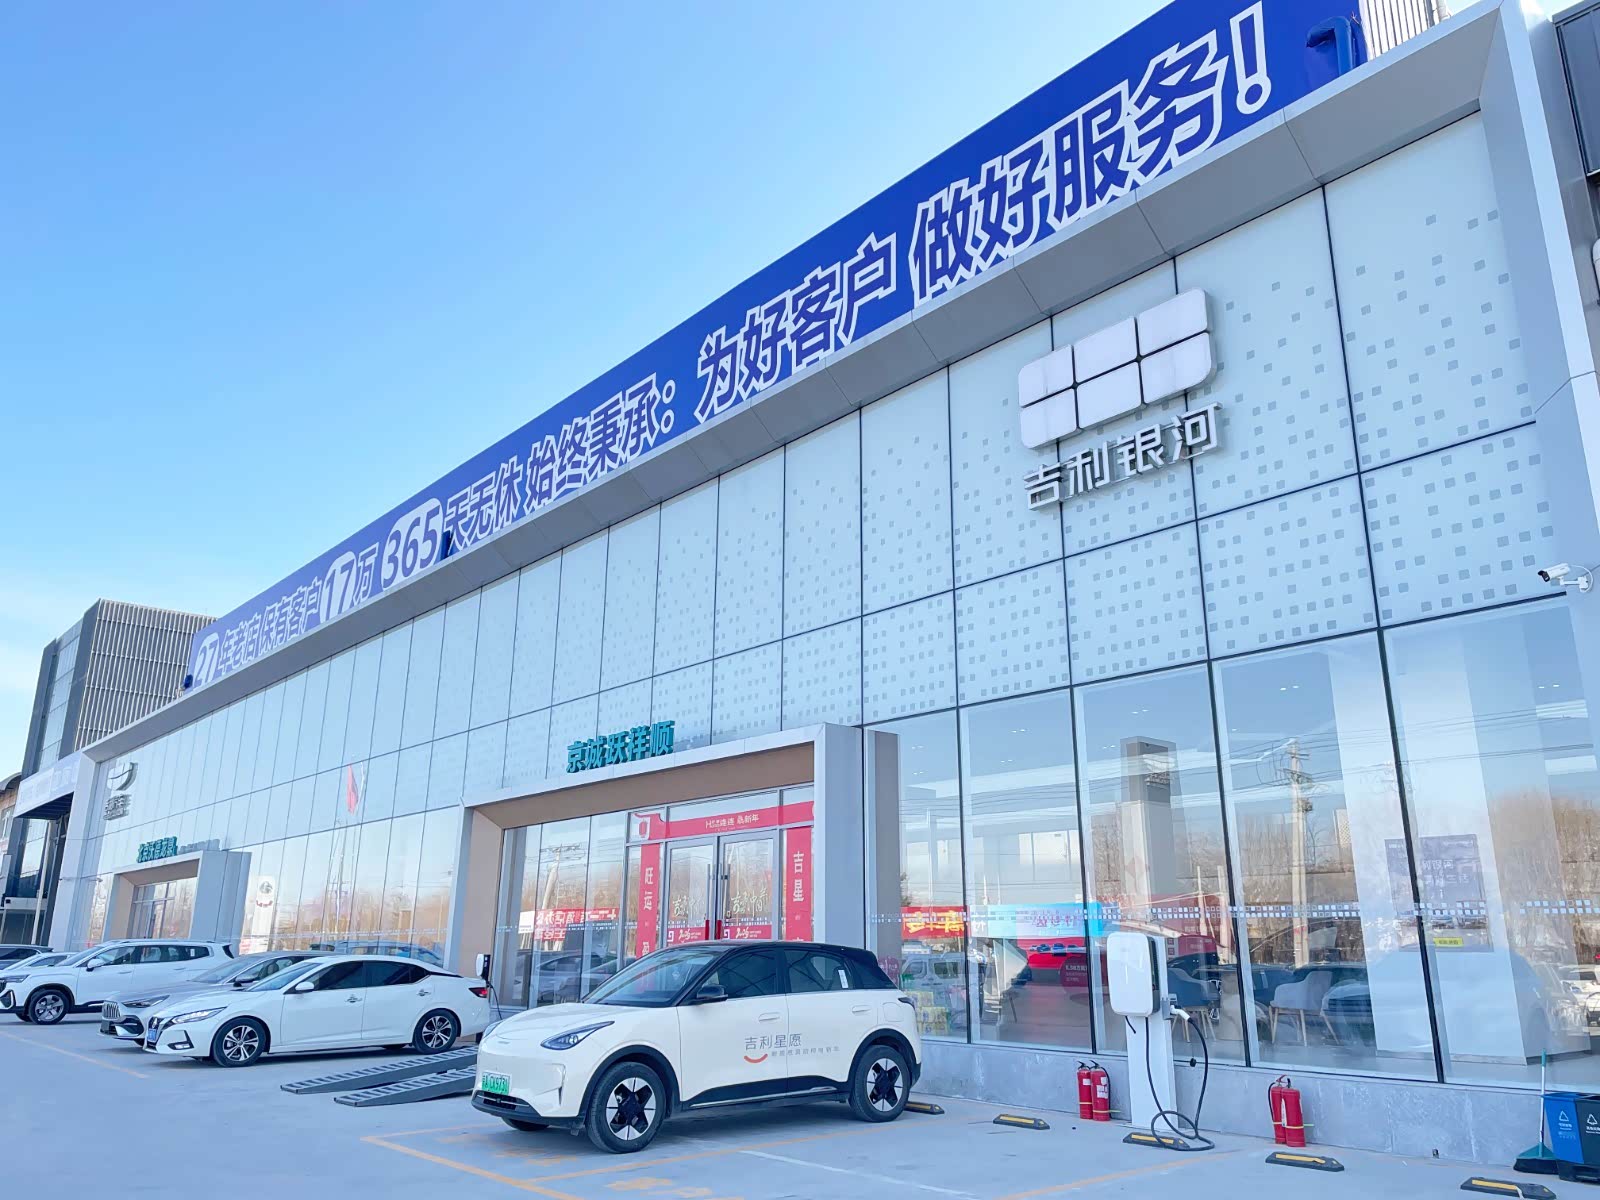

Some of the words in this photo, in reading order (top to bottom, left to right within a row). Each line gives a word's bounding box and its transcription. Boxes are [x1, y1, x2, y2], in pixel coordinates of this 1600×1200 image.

[381, 455, 523, 592] 365天无休
[523, 372, 676, 514] 始终秉承：
[694, 231, 896, 424] 为好客户
[907, 0, 1273, 307] 做好服务！
[1023, 402, 1223, 510] 吉利银河
[792, 850, 805, 902] 吉星
[744, 1033, 802, 1051] 吉利星愿
